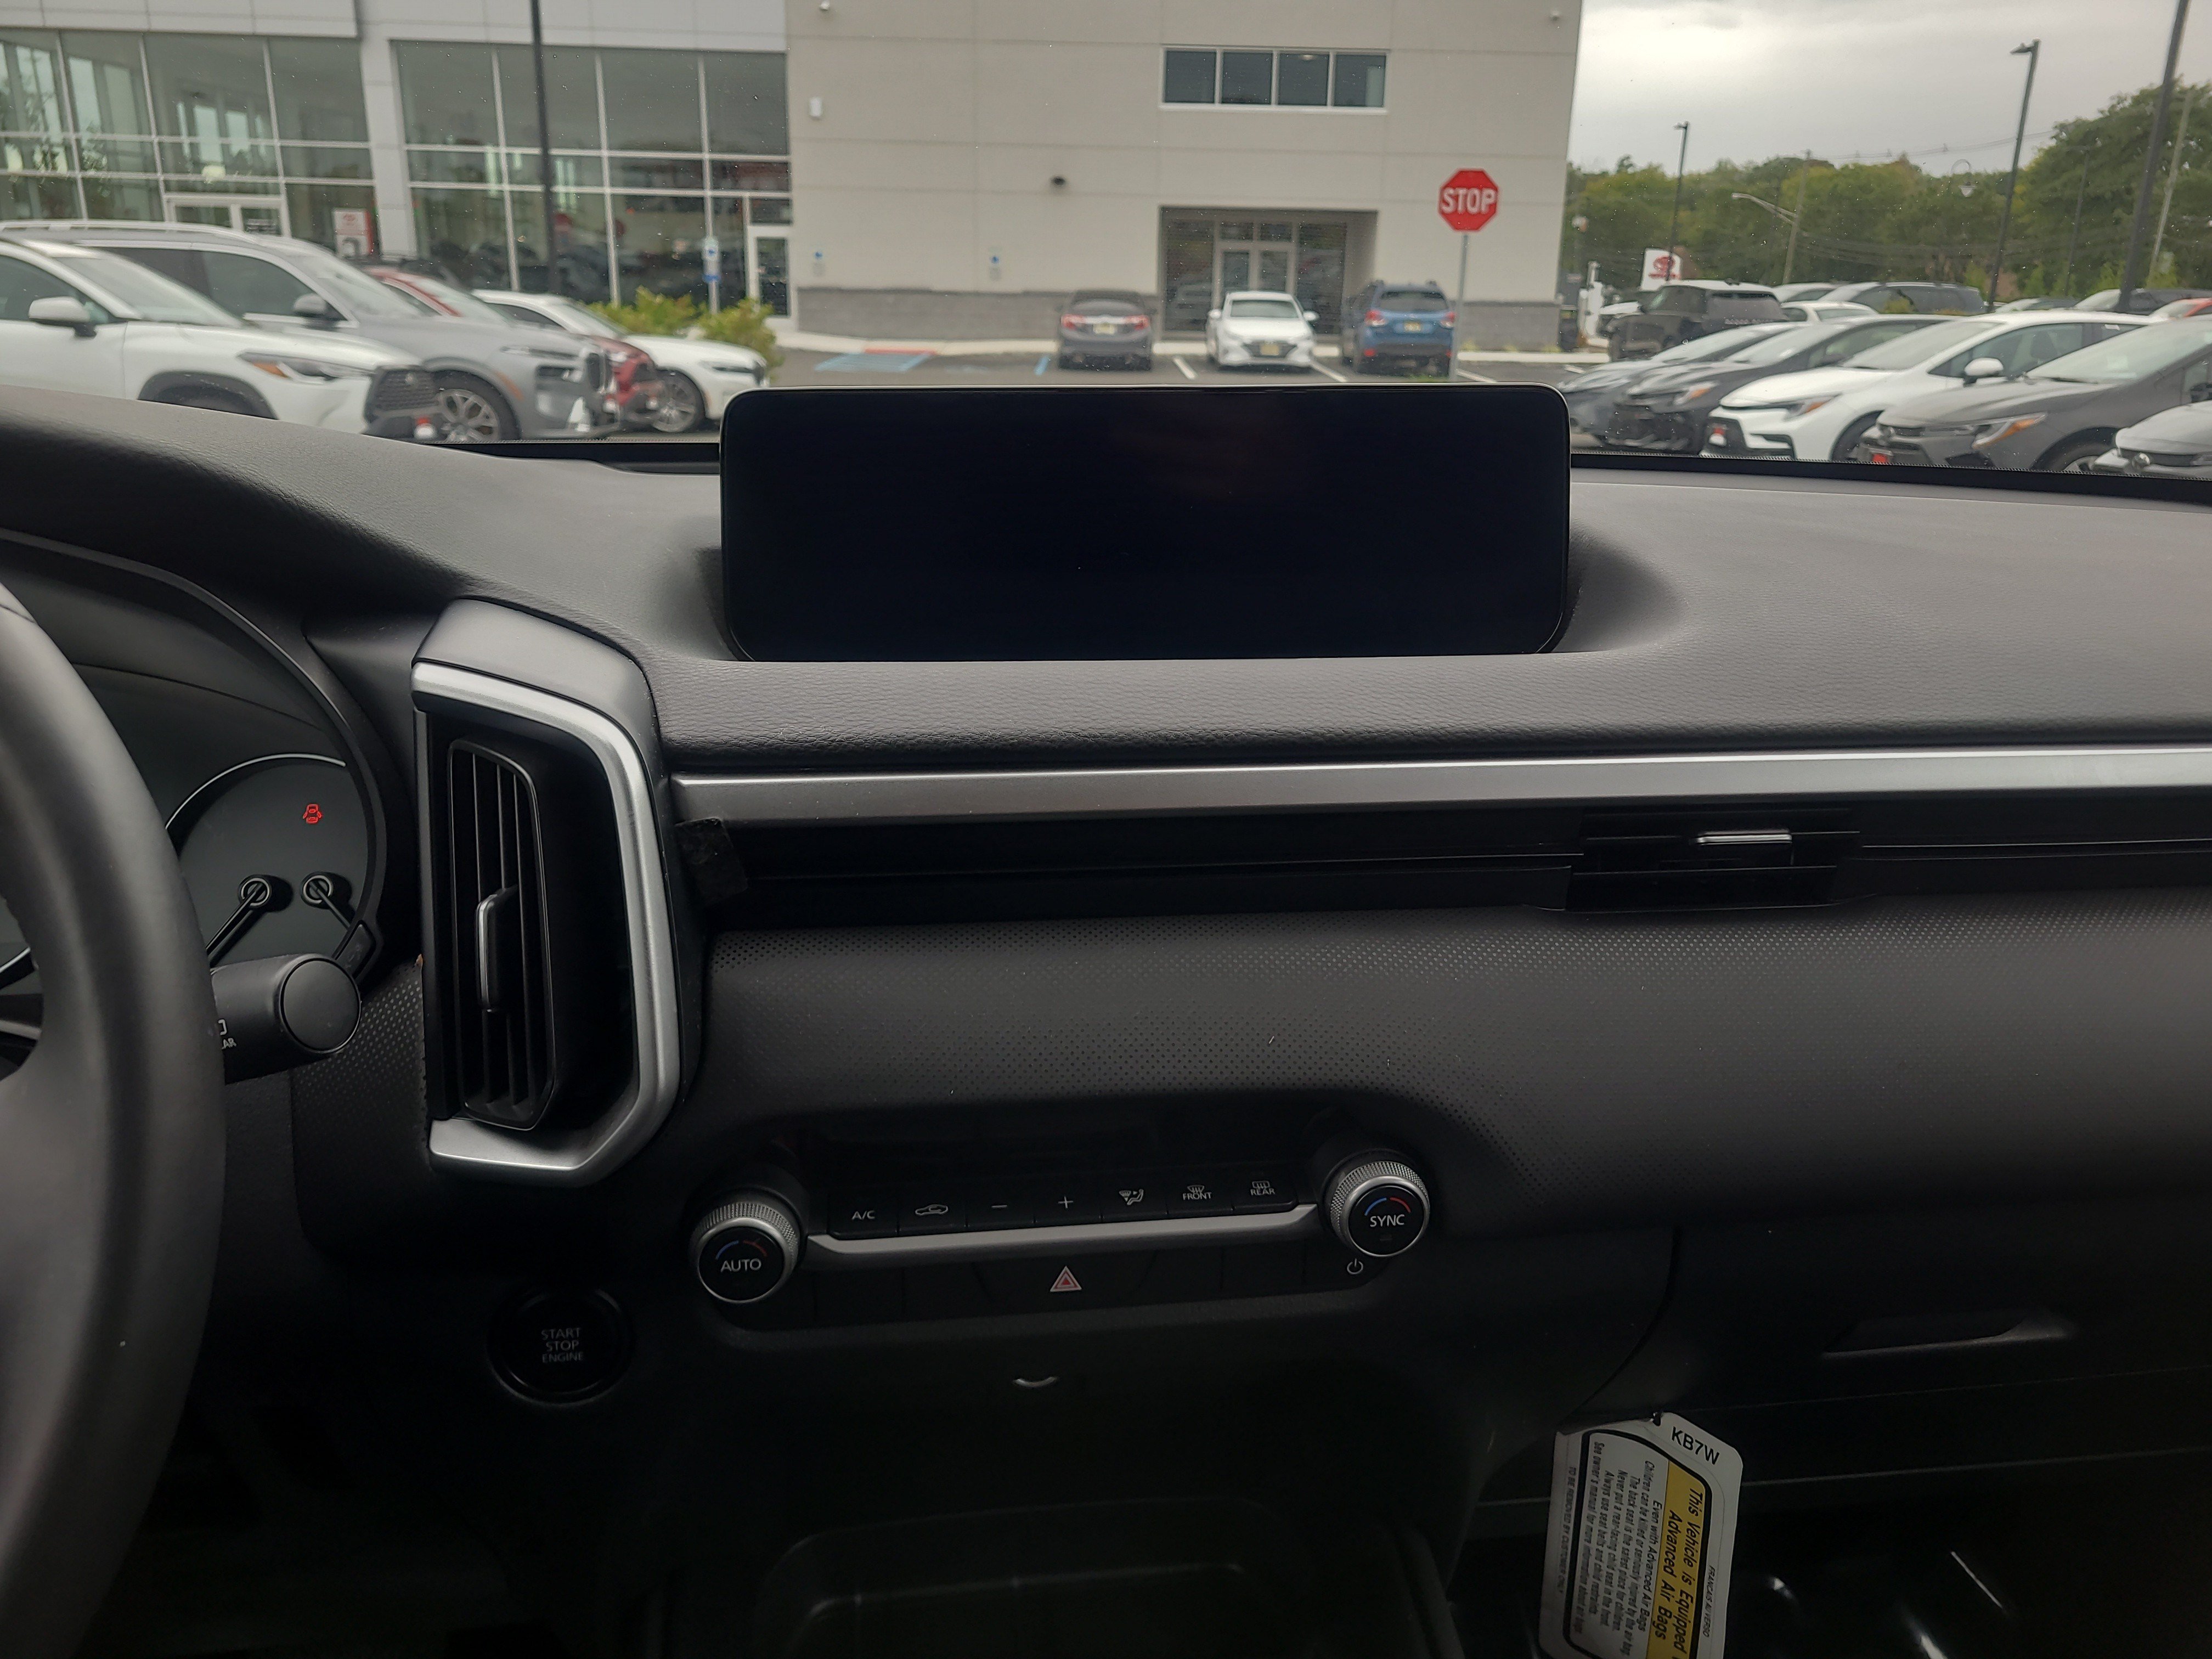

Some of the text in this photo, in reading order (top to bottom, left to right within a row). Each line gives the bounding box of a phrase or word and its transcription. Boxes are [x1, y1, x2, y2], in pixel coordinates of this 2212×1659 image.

[1441, 187, 1496, 213] STOP
[1183, 1192, 1212, 1200] FRONT
[851, 1210, 876, 1220] A/C
[1370, 1214, 1405, 1227] SYNC
[720, 1258, 761, 1273] AUTO
[541, 1328, 581, 1340] START
[546, 1340, 579, 1352] STOP
[542, 1351, 584, 1363] ENGINE
[1672, 1426, 1720, 1465] KB7W
[1637, 1500, 1662, 1631] Even with Advanced Air Bags
[1673, 1489, 1703, 1652] This Vehicle is Equipped
[1653, 1512, 1682, 1638] Advanced Air Bags
